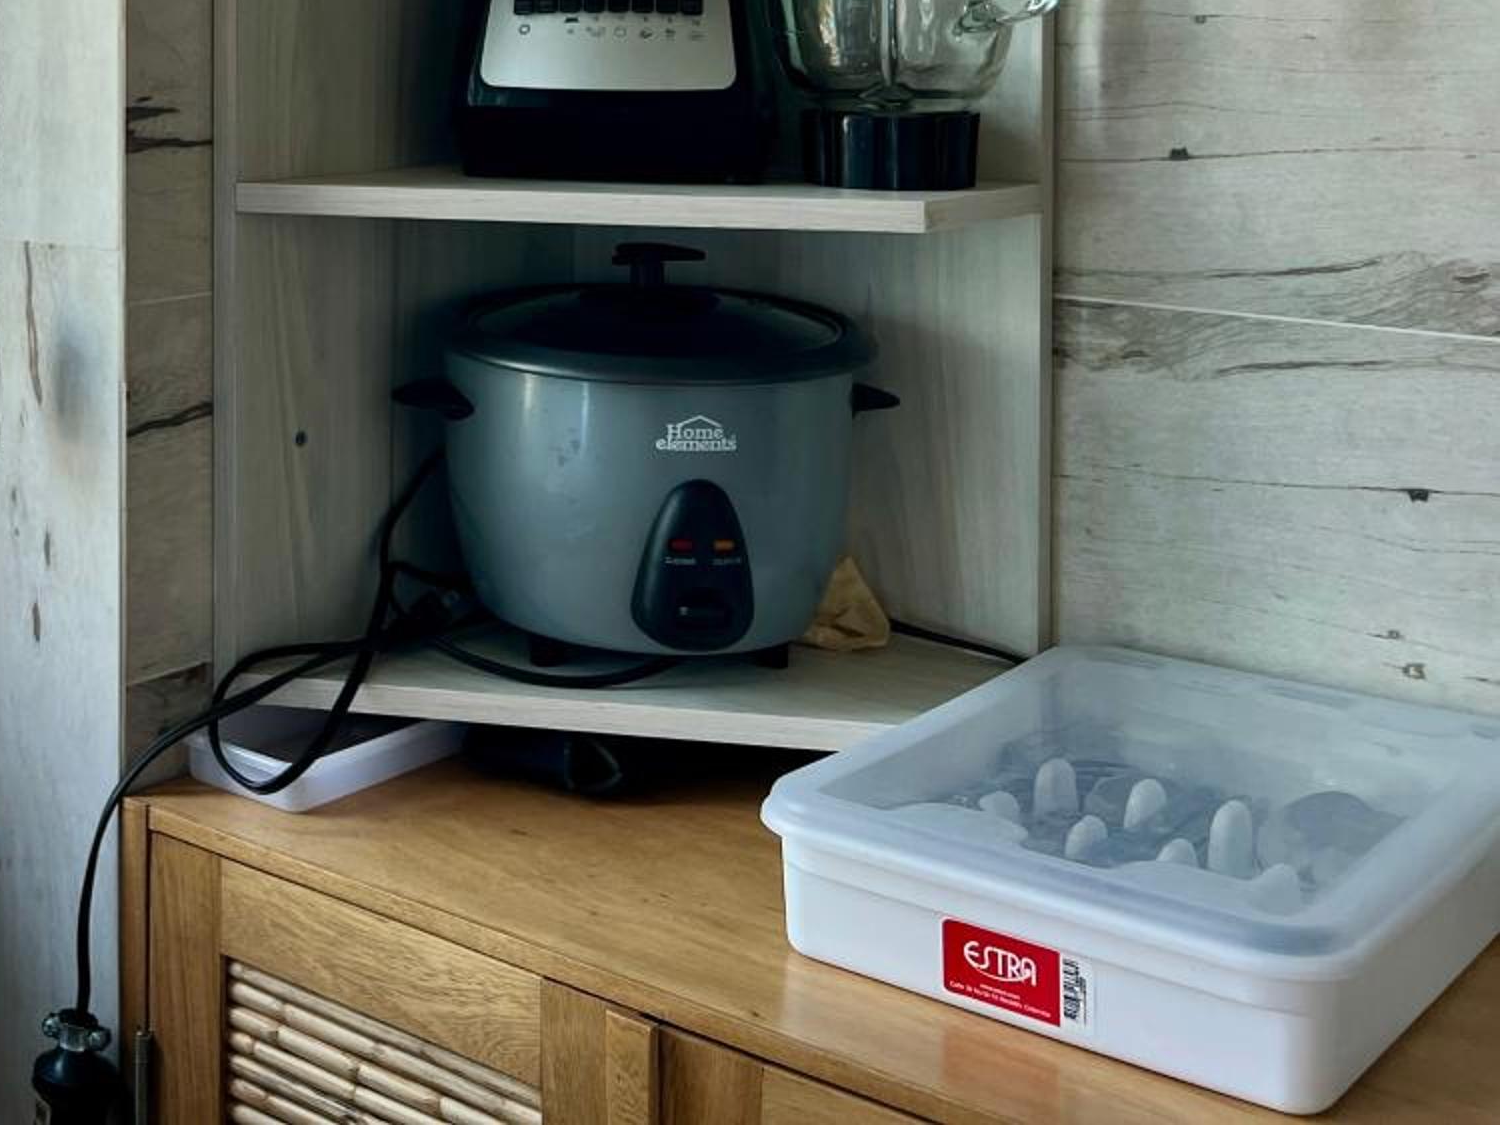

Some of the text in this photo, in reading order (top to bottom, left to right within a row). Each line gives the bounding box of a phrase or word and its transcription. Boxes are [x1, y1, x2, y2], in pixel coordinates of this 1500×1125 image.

[666, 423, 724, 440] Home
[655, 435, 738, 452] elements
[963, 941, 1037, 987] ESTRA
